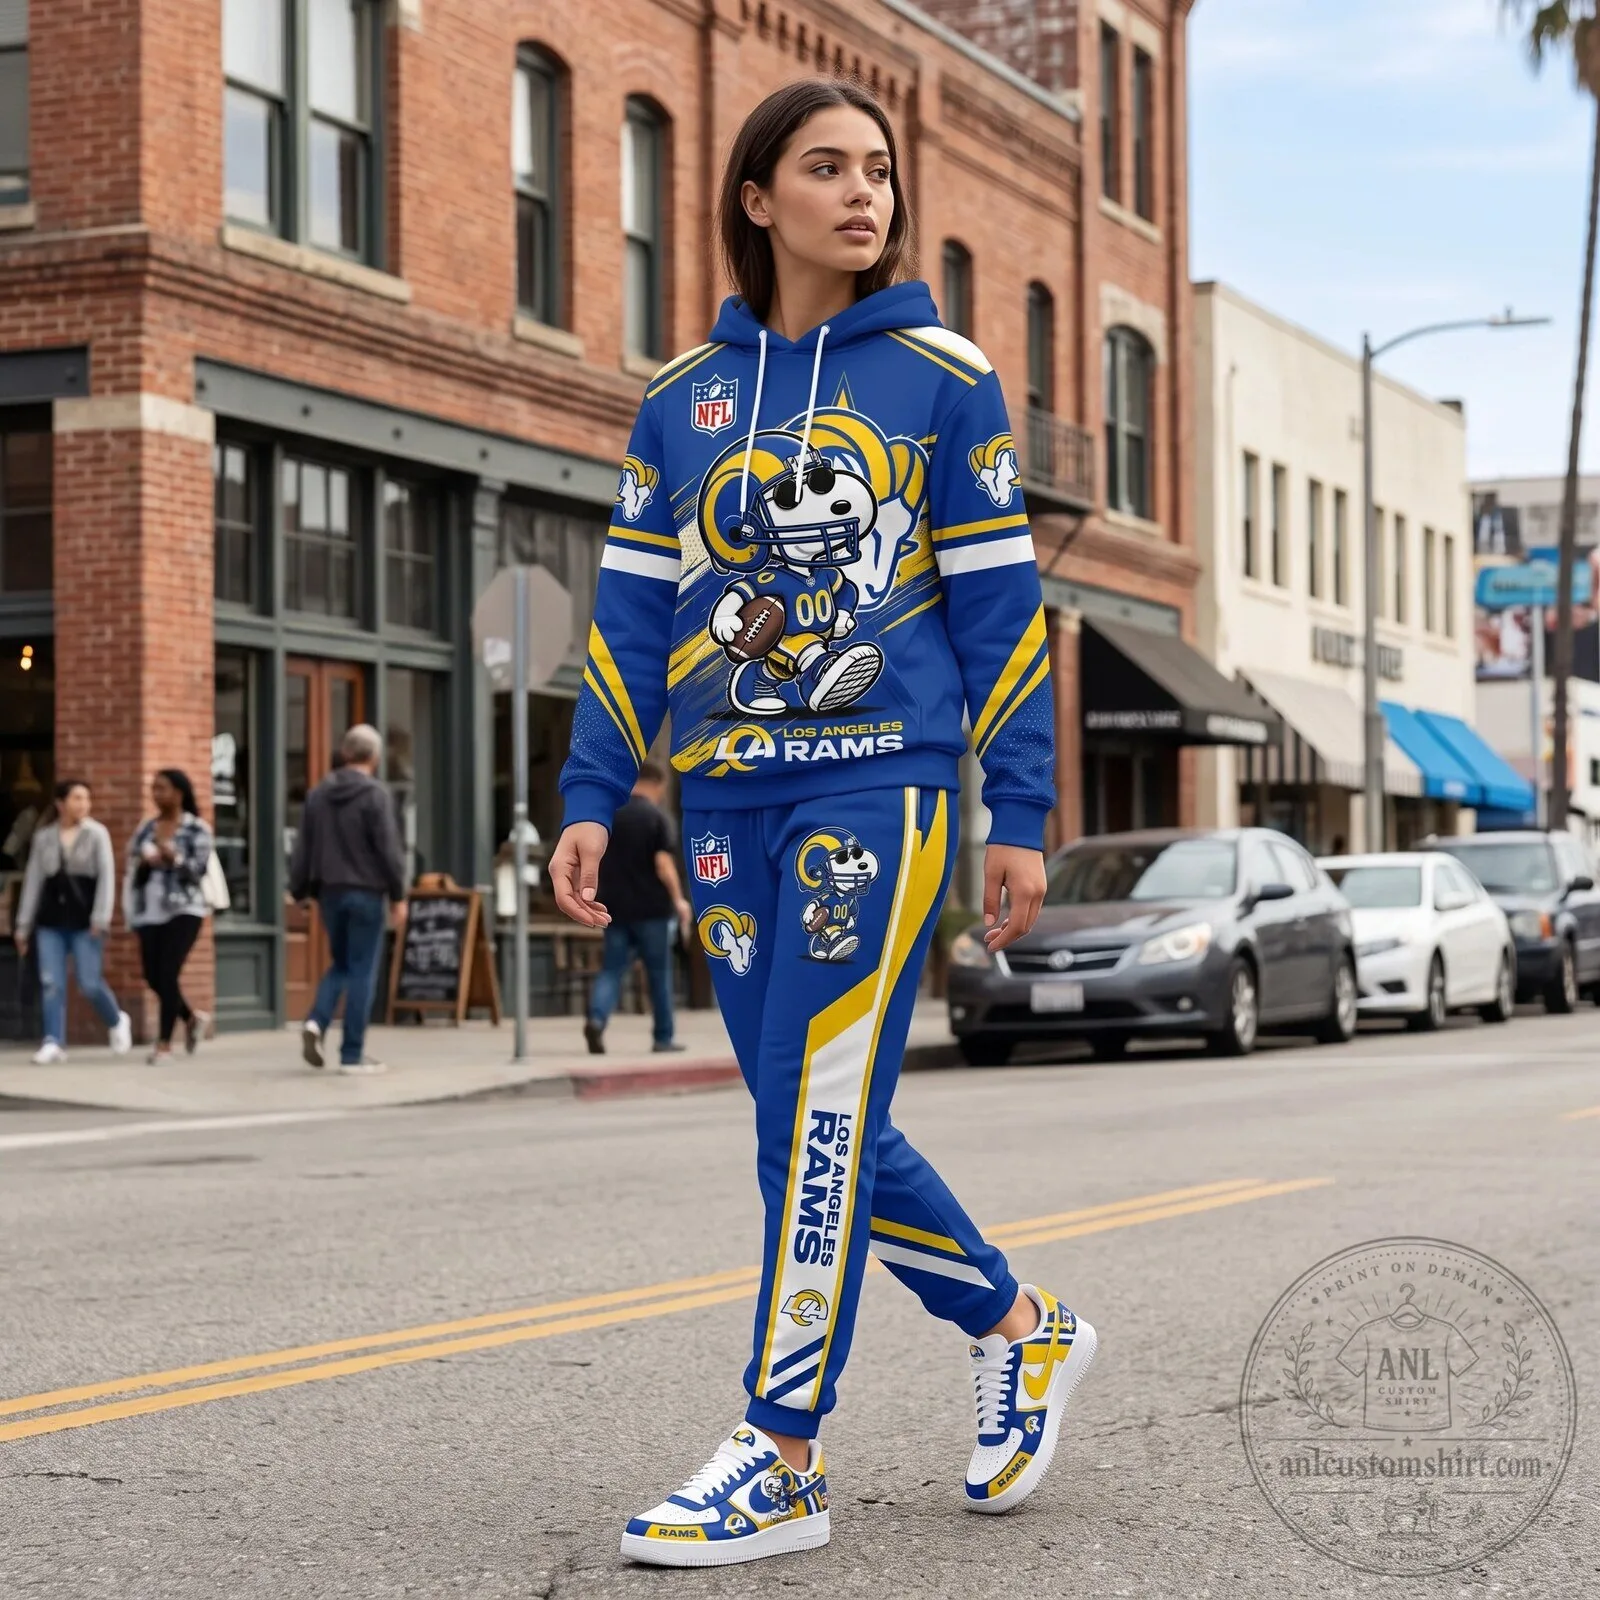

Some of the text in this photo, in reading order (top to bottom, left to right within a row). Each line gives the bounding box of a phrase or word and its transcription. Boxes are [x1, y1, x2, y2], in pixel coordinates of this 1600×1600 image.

[697, 401, 731, 427] NFL
[795, 589, 832, 627] 00
[783, 721, 904, 738] LOS ANGELES
[784, 734, 904, 762] RAMS
[696, 854, 728, 880] NFL
[833, 904, 848, 920] 00
[793, 1109, 839, 1265] RAMS
[821, 1113, 852, 1267] LOS ANGELES
[997, 1457, 1028, 1488] RAMS
[658, 1528, 699, 1538] RAMS
